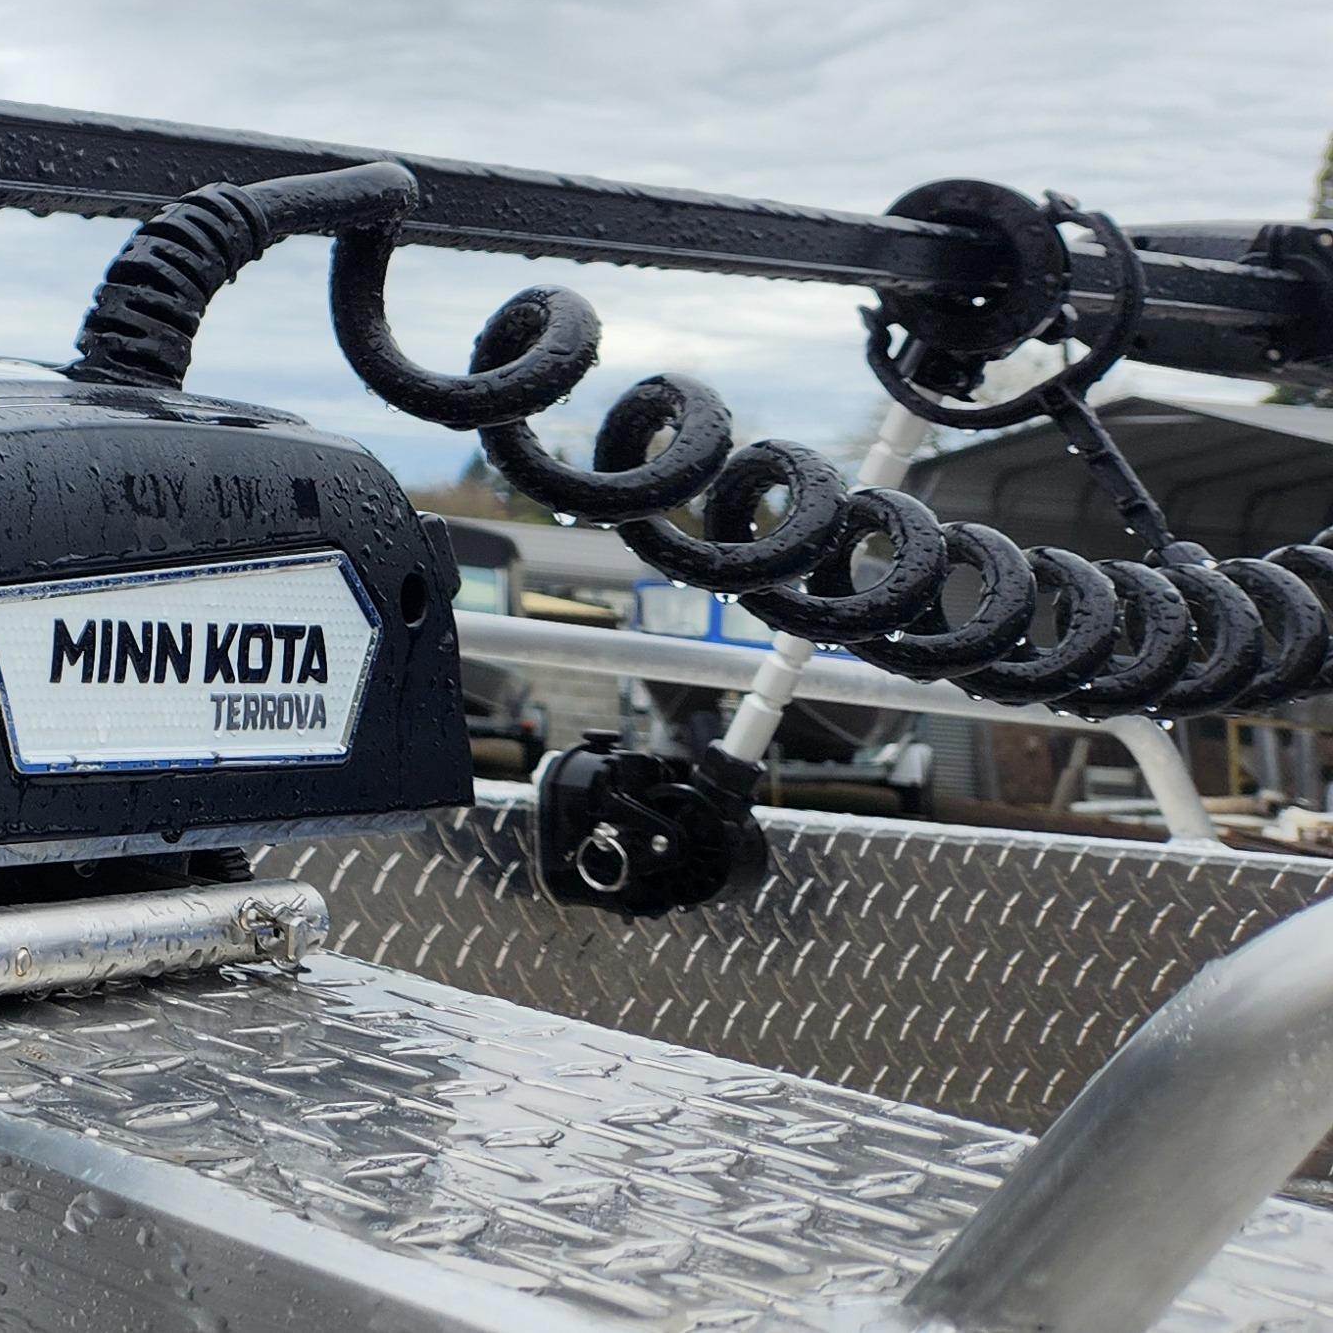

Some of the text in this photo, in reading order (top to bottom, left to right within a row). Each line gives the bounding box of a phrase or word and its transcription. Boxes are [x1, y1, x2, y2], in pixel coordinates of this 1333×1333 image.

[49, 618, 329, 684] MINN KOTA
[210, 692, 328, 731] TERROVA
